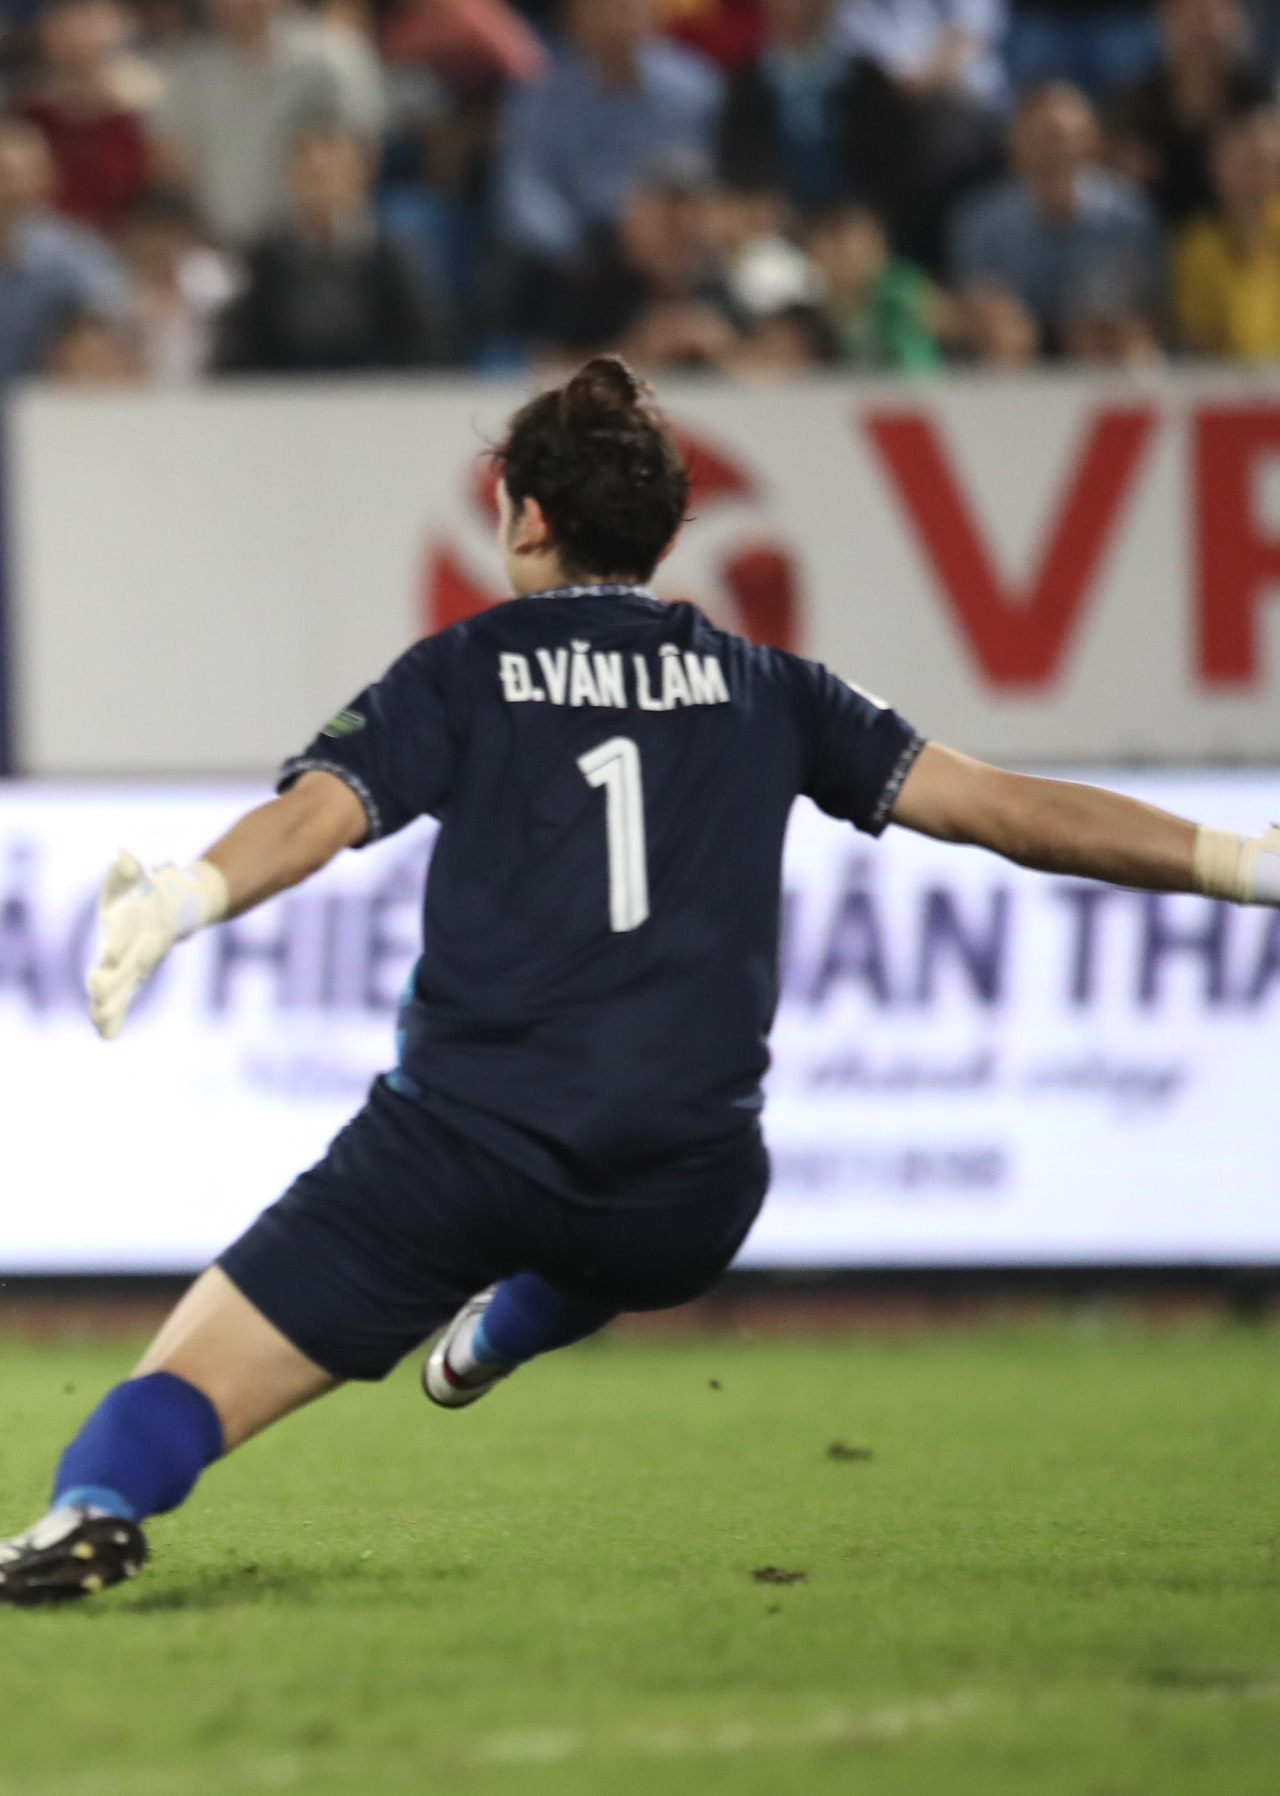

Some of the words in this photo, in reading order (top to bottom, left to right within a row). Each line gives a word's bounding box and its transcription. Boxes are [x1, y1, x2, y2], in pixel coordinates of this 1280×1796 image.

[498, 638, 627, 710] Đ.VĂN
[632, 642, 731, 712] LÂM
[575, 735, 651, 934] 1
